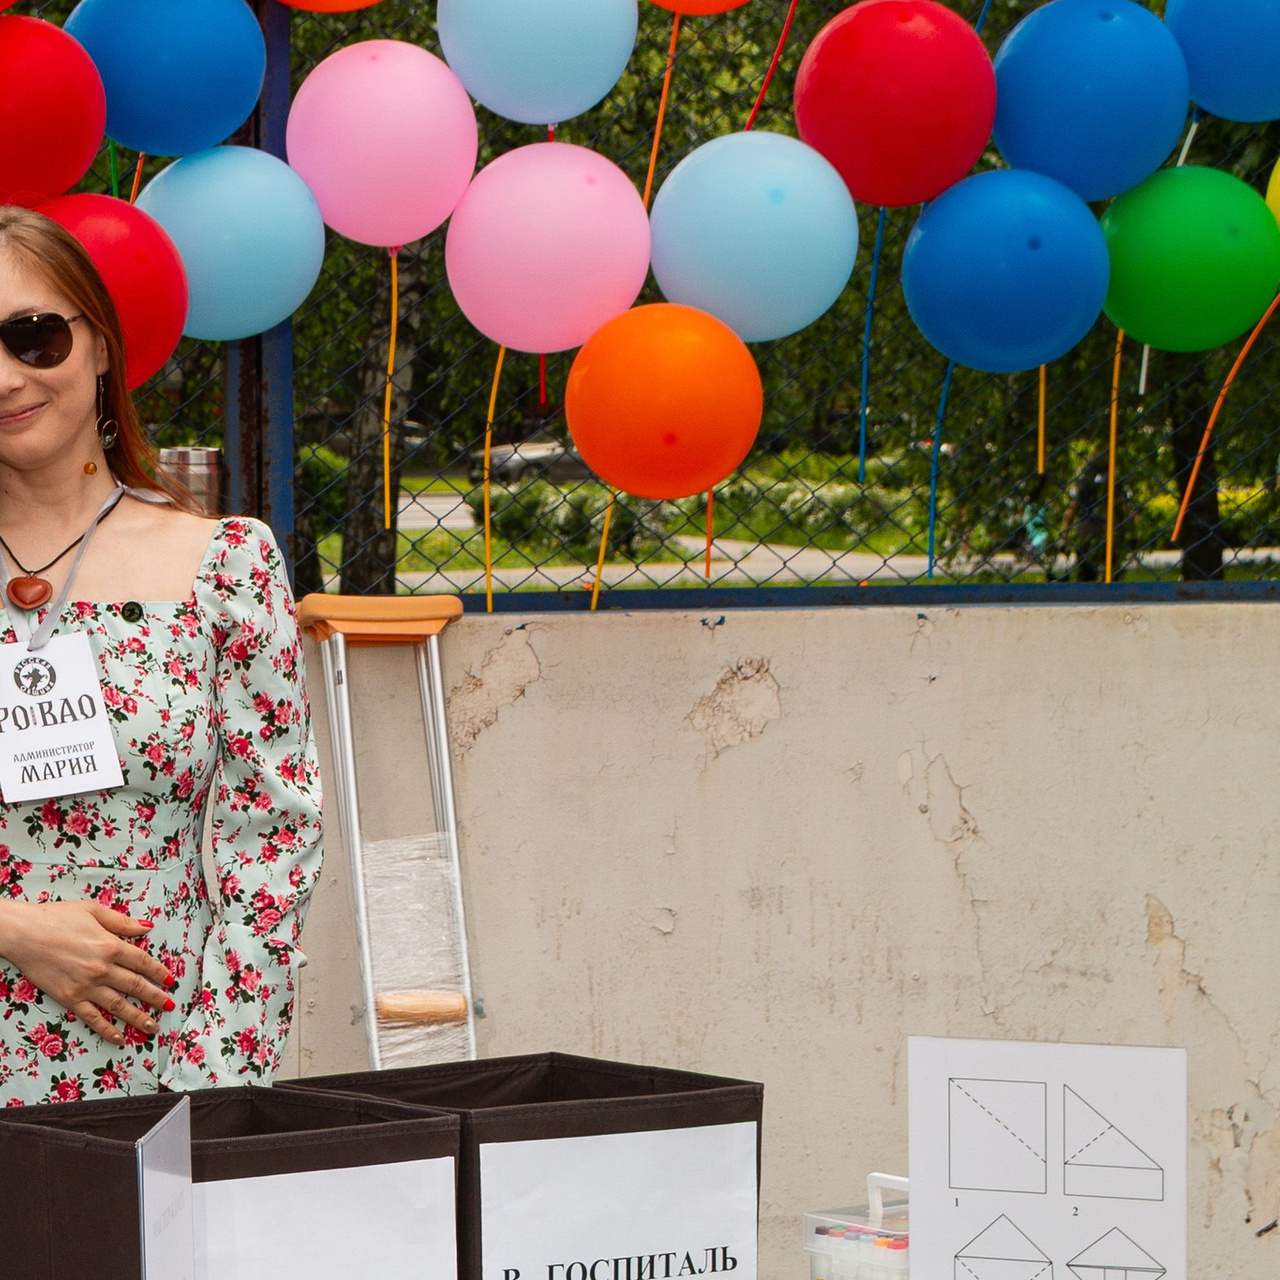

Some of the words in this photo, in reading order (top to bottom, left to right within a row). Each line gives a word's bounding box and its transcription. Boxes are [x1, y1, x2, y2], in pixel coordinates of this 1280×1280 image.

[12, 741, 95, 763] АДМИНИСТРАТОР
[20, 754, 99, 785] МАРИЯ
[955, 1198, 959, 1207] 1
[1072, 1207, 1079, 1216] 2
